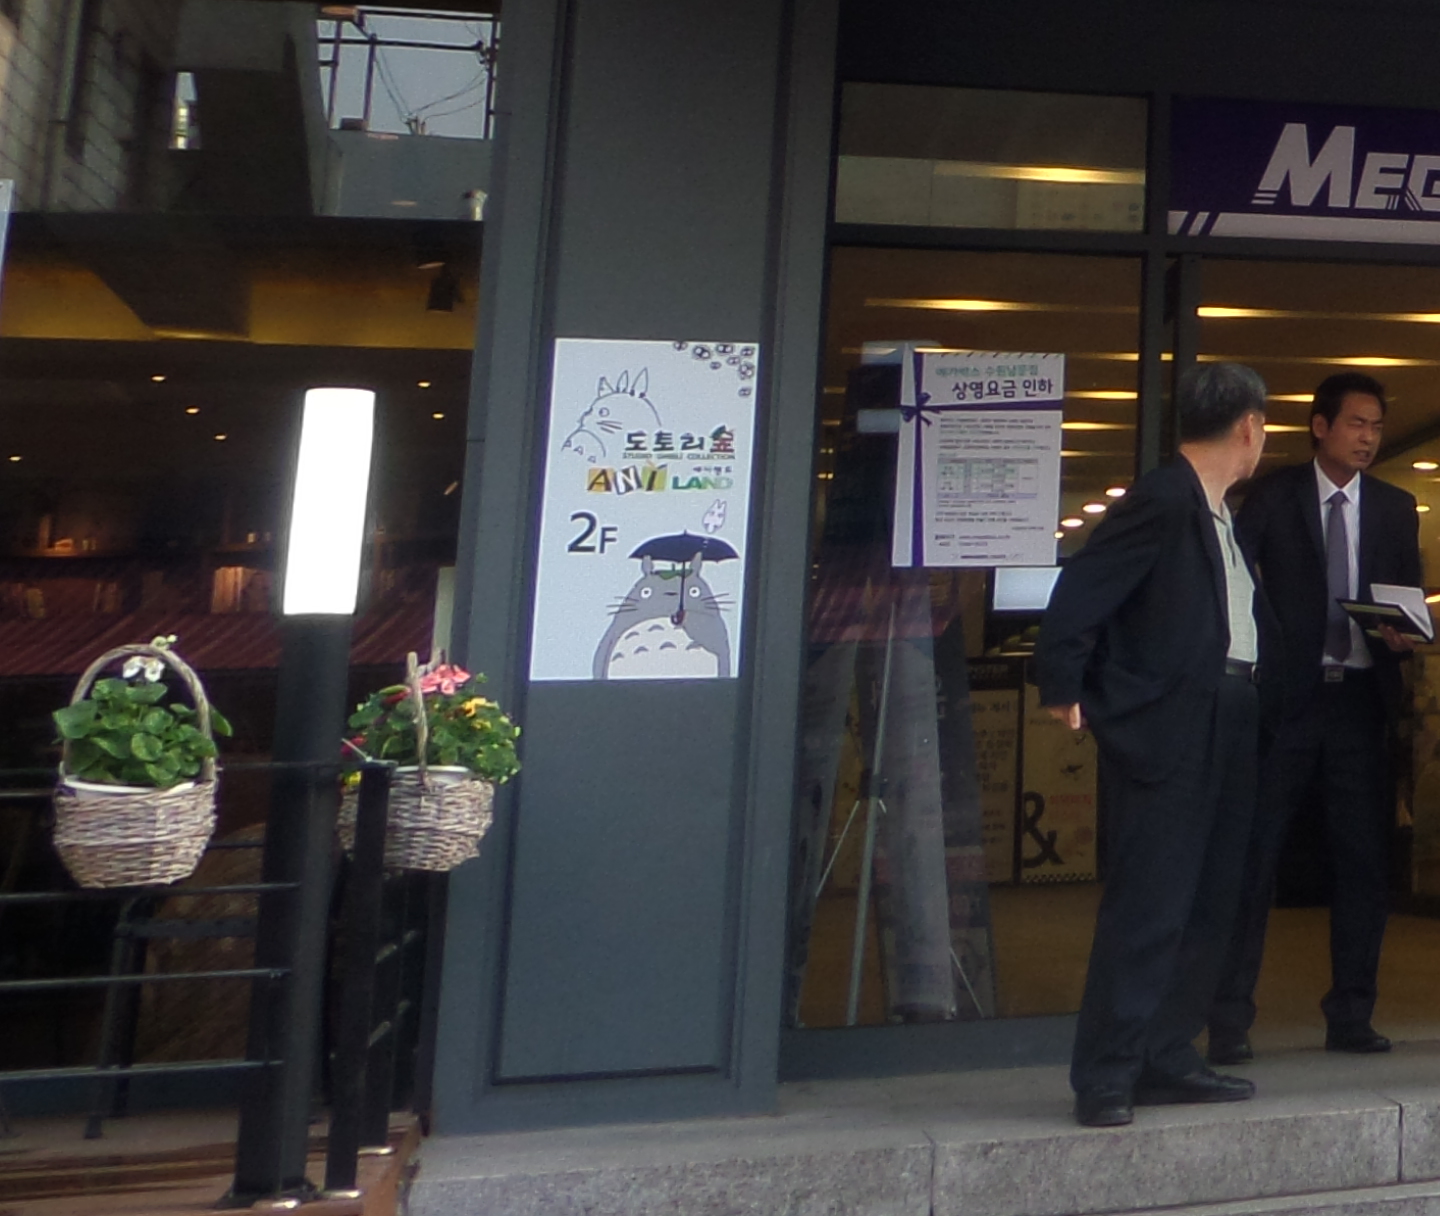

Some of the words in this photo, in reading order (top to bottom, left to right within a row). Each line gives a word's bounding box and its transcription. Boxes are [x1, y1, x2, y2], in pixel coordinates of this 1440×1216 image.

[952, 379, 1018, 400] 상영요금
[1022, 378, 1053, 397] 인하
[624, 426, 736, 454] 도토리숲
[672, 476, 734, 489] LAND
[567, 512, 618, 554] 2F
